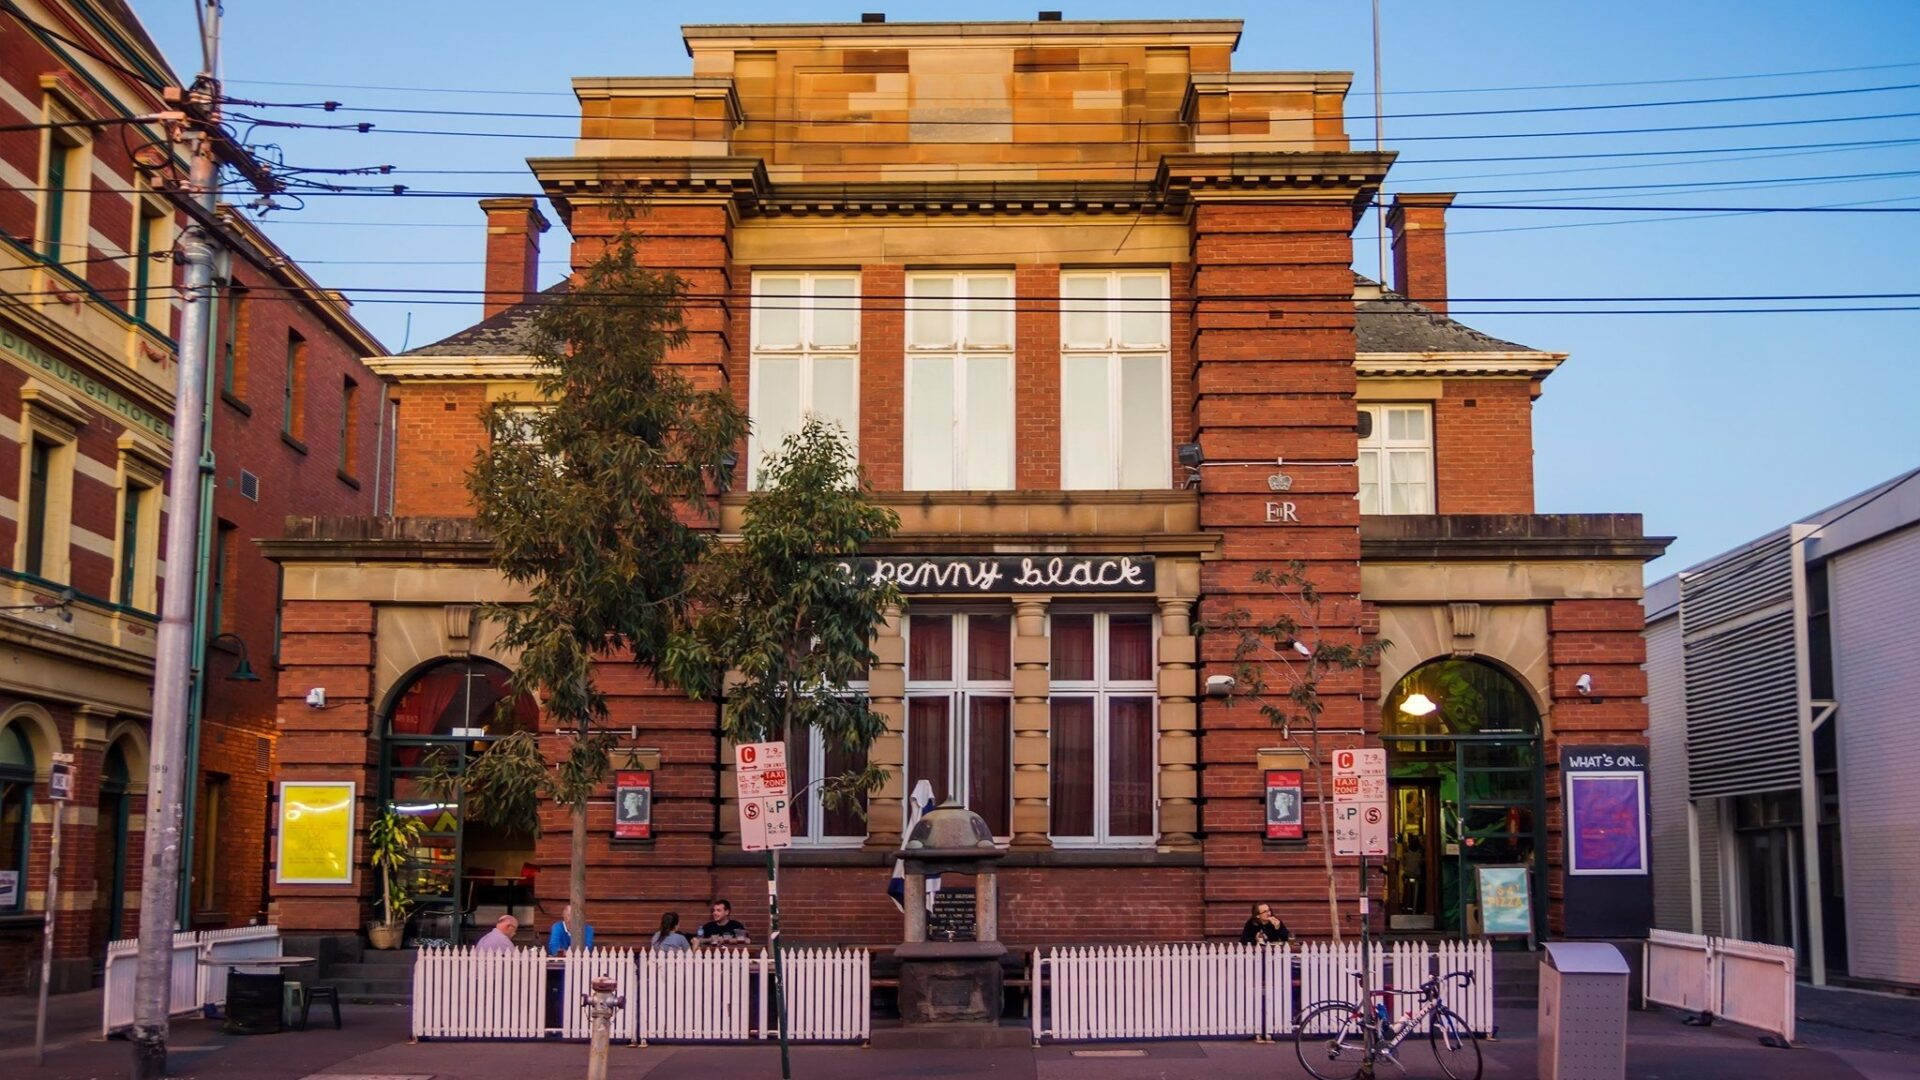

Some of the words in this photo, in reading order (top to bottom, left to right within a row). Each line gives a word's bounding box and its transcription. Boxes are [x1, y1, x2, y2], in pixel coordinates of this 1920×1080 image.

[0, 332, 110, 404] DINBURGH
[870, 558, 1002, 590] penny
[1014, 557, 1145, 585] black
[1569, 753, 1614, 768] WHAT'S
[765, 770, 785, 779] TAXI
[763, 779, 785, 788] ZONE
[1336, 778, 1357, 786] TAXI
[1335, 786, 1358, 794] ZONE
[776, 800, 786, 813] P
[1347, 807, 1357, 820] P
